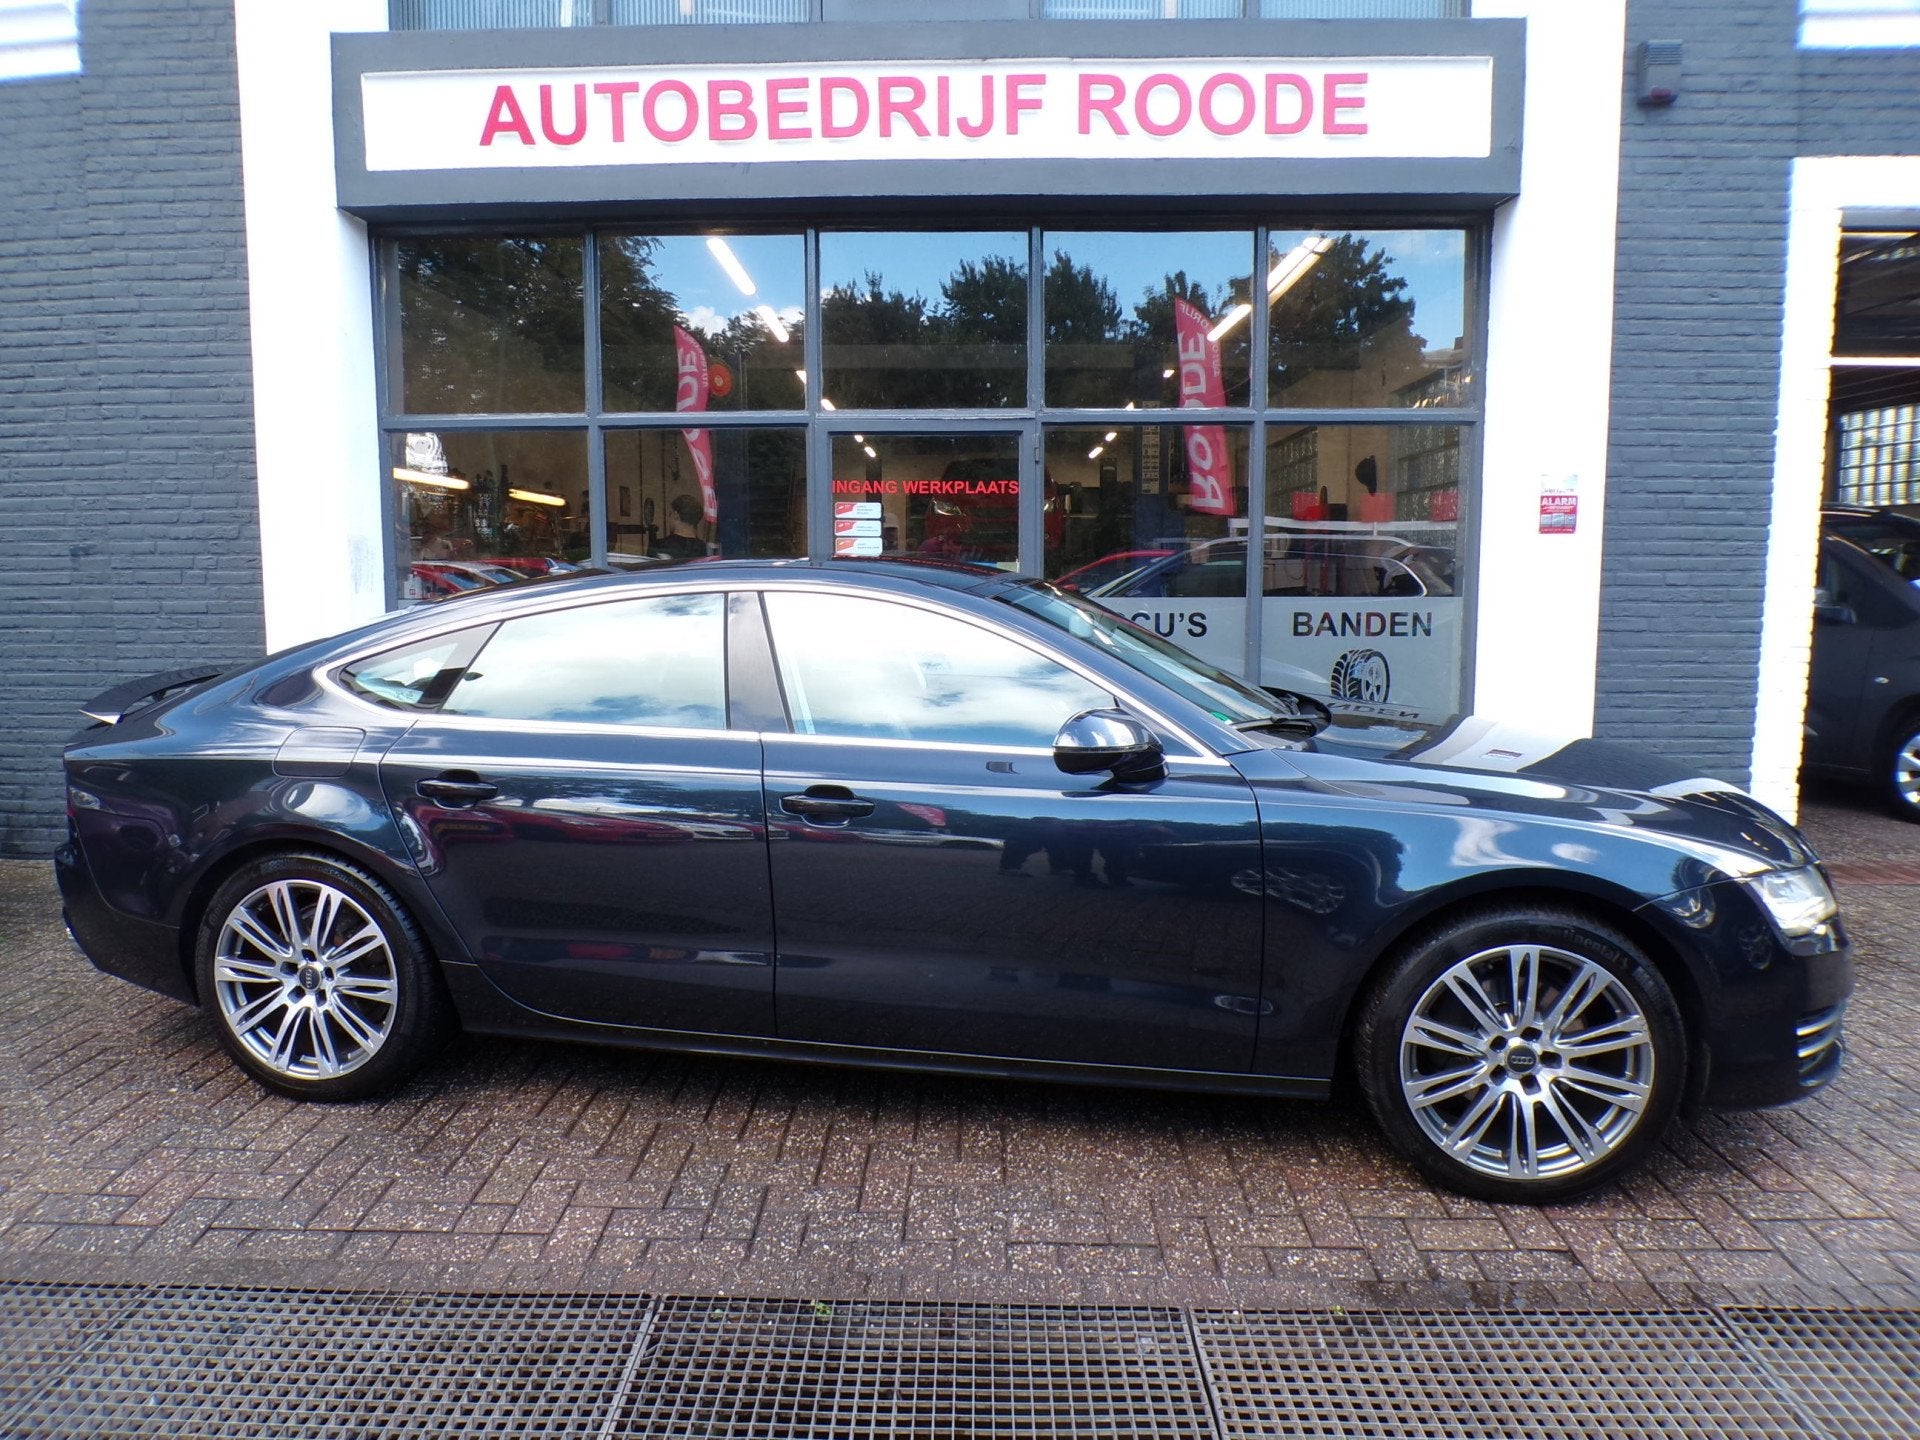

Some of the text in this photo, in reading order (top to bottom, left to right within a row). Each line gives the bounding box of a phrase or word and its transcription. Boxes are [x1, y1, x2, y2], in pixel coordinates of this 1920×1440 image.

[480, 73, 1369, 146] AUTOBEDRIJF ROODE
[833, 480, 1020, 496] INGANG WERKPLAATS
[1541, 497, 1577, 506] ALARM
[1293, 612, 1432, 638] BANDEN
